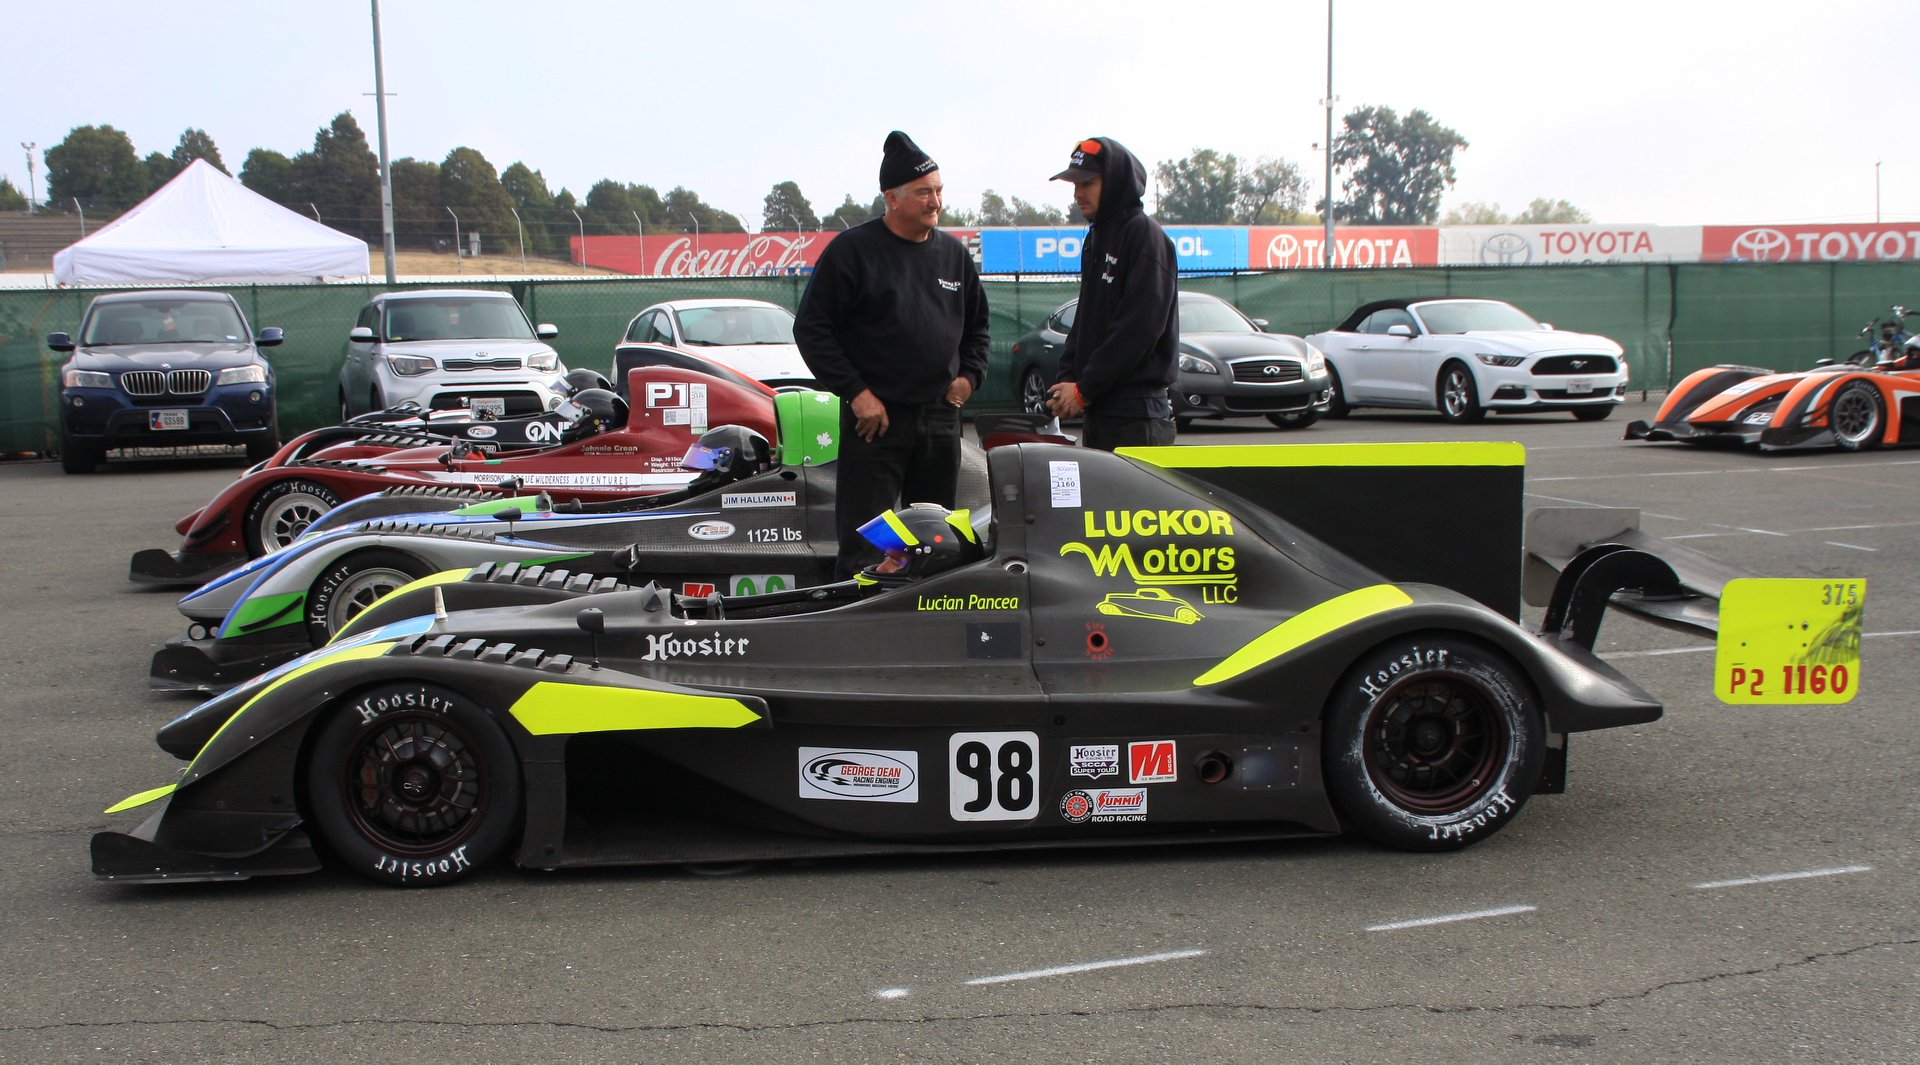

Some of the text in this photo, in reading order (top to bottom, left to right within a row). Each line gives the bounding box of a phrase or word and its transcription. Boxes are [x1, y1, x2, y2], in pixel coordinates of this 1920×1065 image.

[653, 235, 816, 276] Coca-Cola
[1540, 231, 1653, 254] TOYOTA
[648, 384, 687, 407] P1
[289, 481, 338, 506] Hoosier
[535, 476, 570, 485] WILDERNESS
[574, 476, 629, 485] ADVENTURES
[723, 495, 783, 505] JIM HALLMAN
[747, 527, 802, 542] 1125 lbs
[1084, 509, 1234, 538] LUCKOR
[1060, 542, 1237, 584] Motors
[311, 565, 350, 627] Hoosier
[917, 594, 1019, 611] Lucian Pancea
[1202, 585, 1238, 604] LLC
[641, 631, 749, 661] Hoosier
[1360, 646, 1448, 701] Hoosier
[1730, 664, 1848, 695] P2 1160
[356, 687, 453, 725] Hoosier
[1073, 747, 1117, 760] Hoosier
[841, 766, 902, 777] GEORGE DEAN
[852, 776, 900, 785] RACING ENGINES
[956, 740, 1034, 812] 98
[1429, 784, 1515, 841] Hoosier
[375, 845, 471, 882] Hoosier
